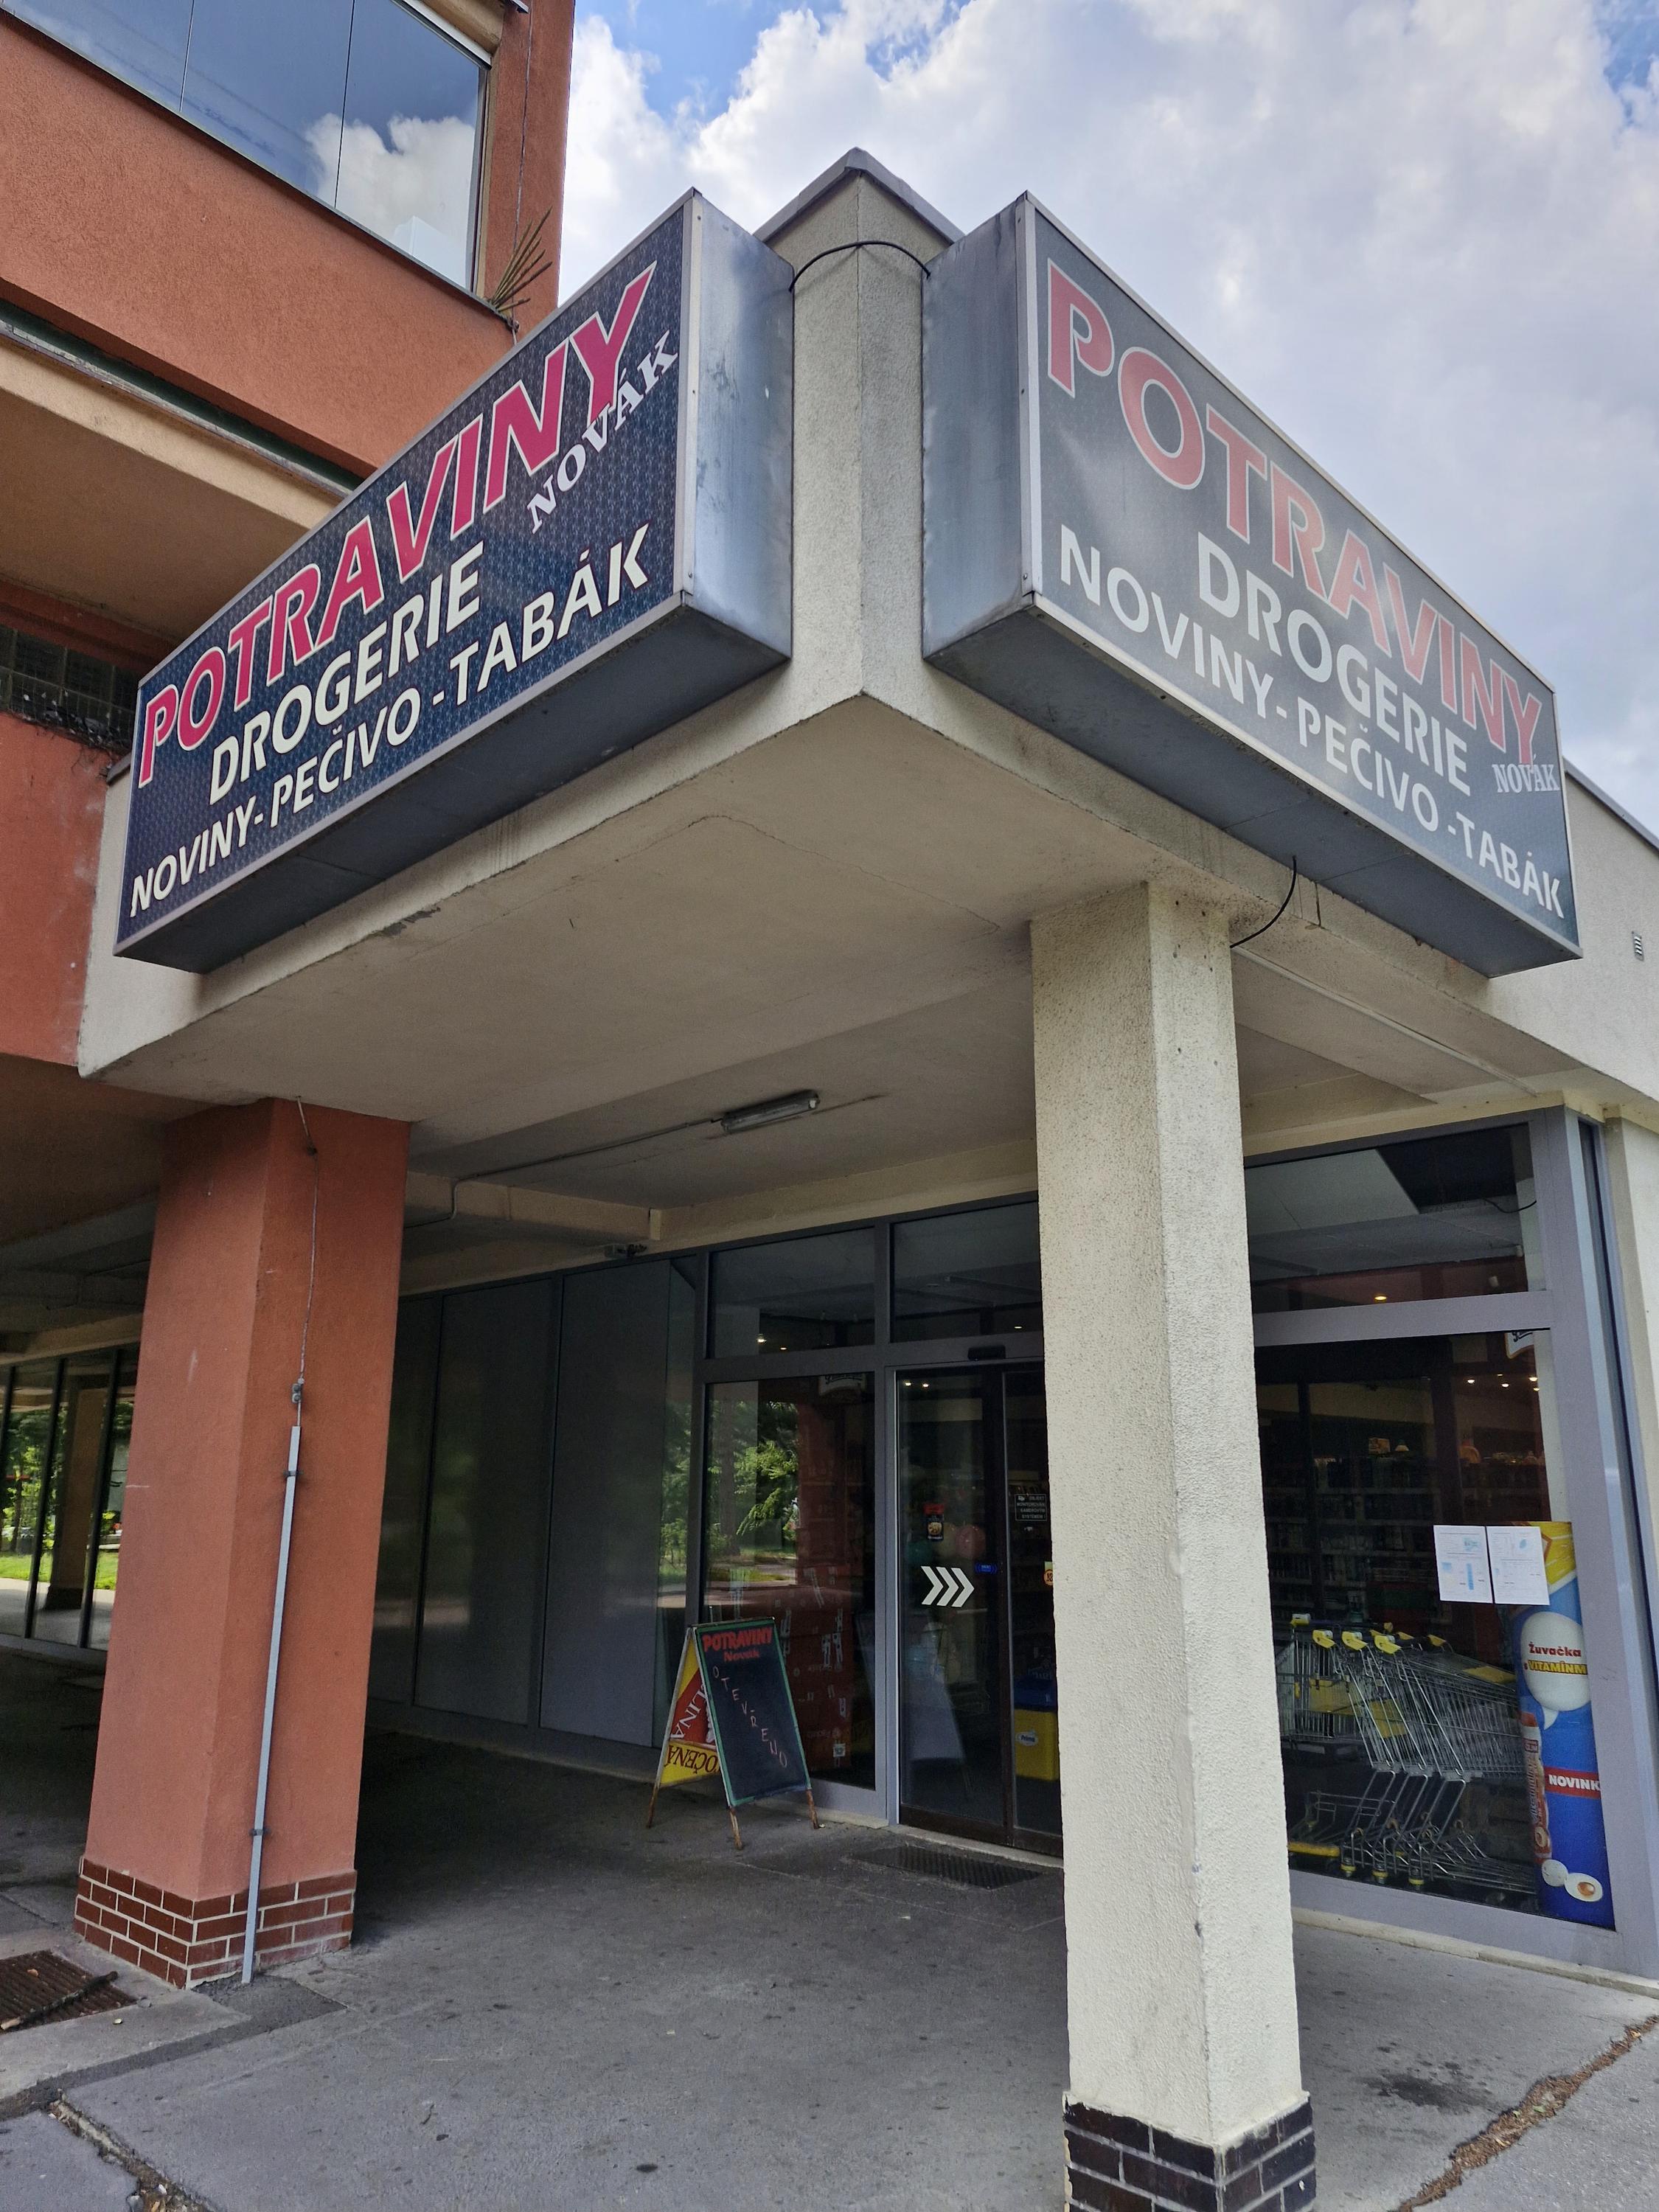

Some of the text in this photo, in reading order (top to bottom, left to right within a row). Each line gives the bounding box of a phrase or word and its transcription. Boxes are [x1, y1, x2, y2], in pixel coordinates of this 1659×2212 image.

[526, 330, 679, 534] NOVÁK
[138, 260, 658, 787] POTRAVINY
[1046, 257, 1543, 765] POTRAVINY
[209, 540, 486, 806] DROGERIE
[1197, 532, 1472, 796] DROGERIE
[1492, 754, 1560, 793] NOVÁK
[702, 1627, 773, 1652] POTRAVINY
[1528, 1641, 1582, 1658] Žuvačka
[664, 1745, 722, 1775] OČENÁ
[669, 1683, 708, 1739] LINA
